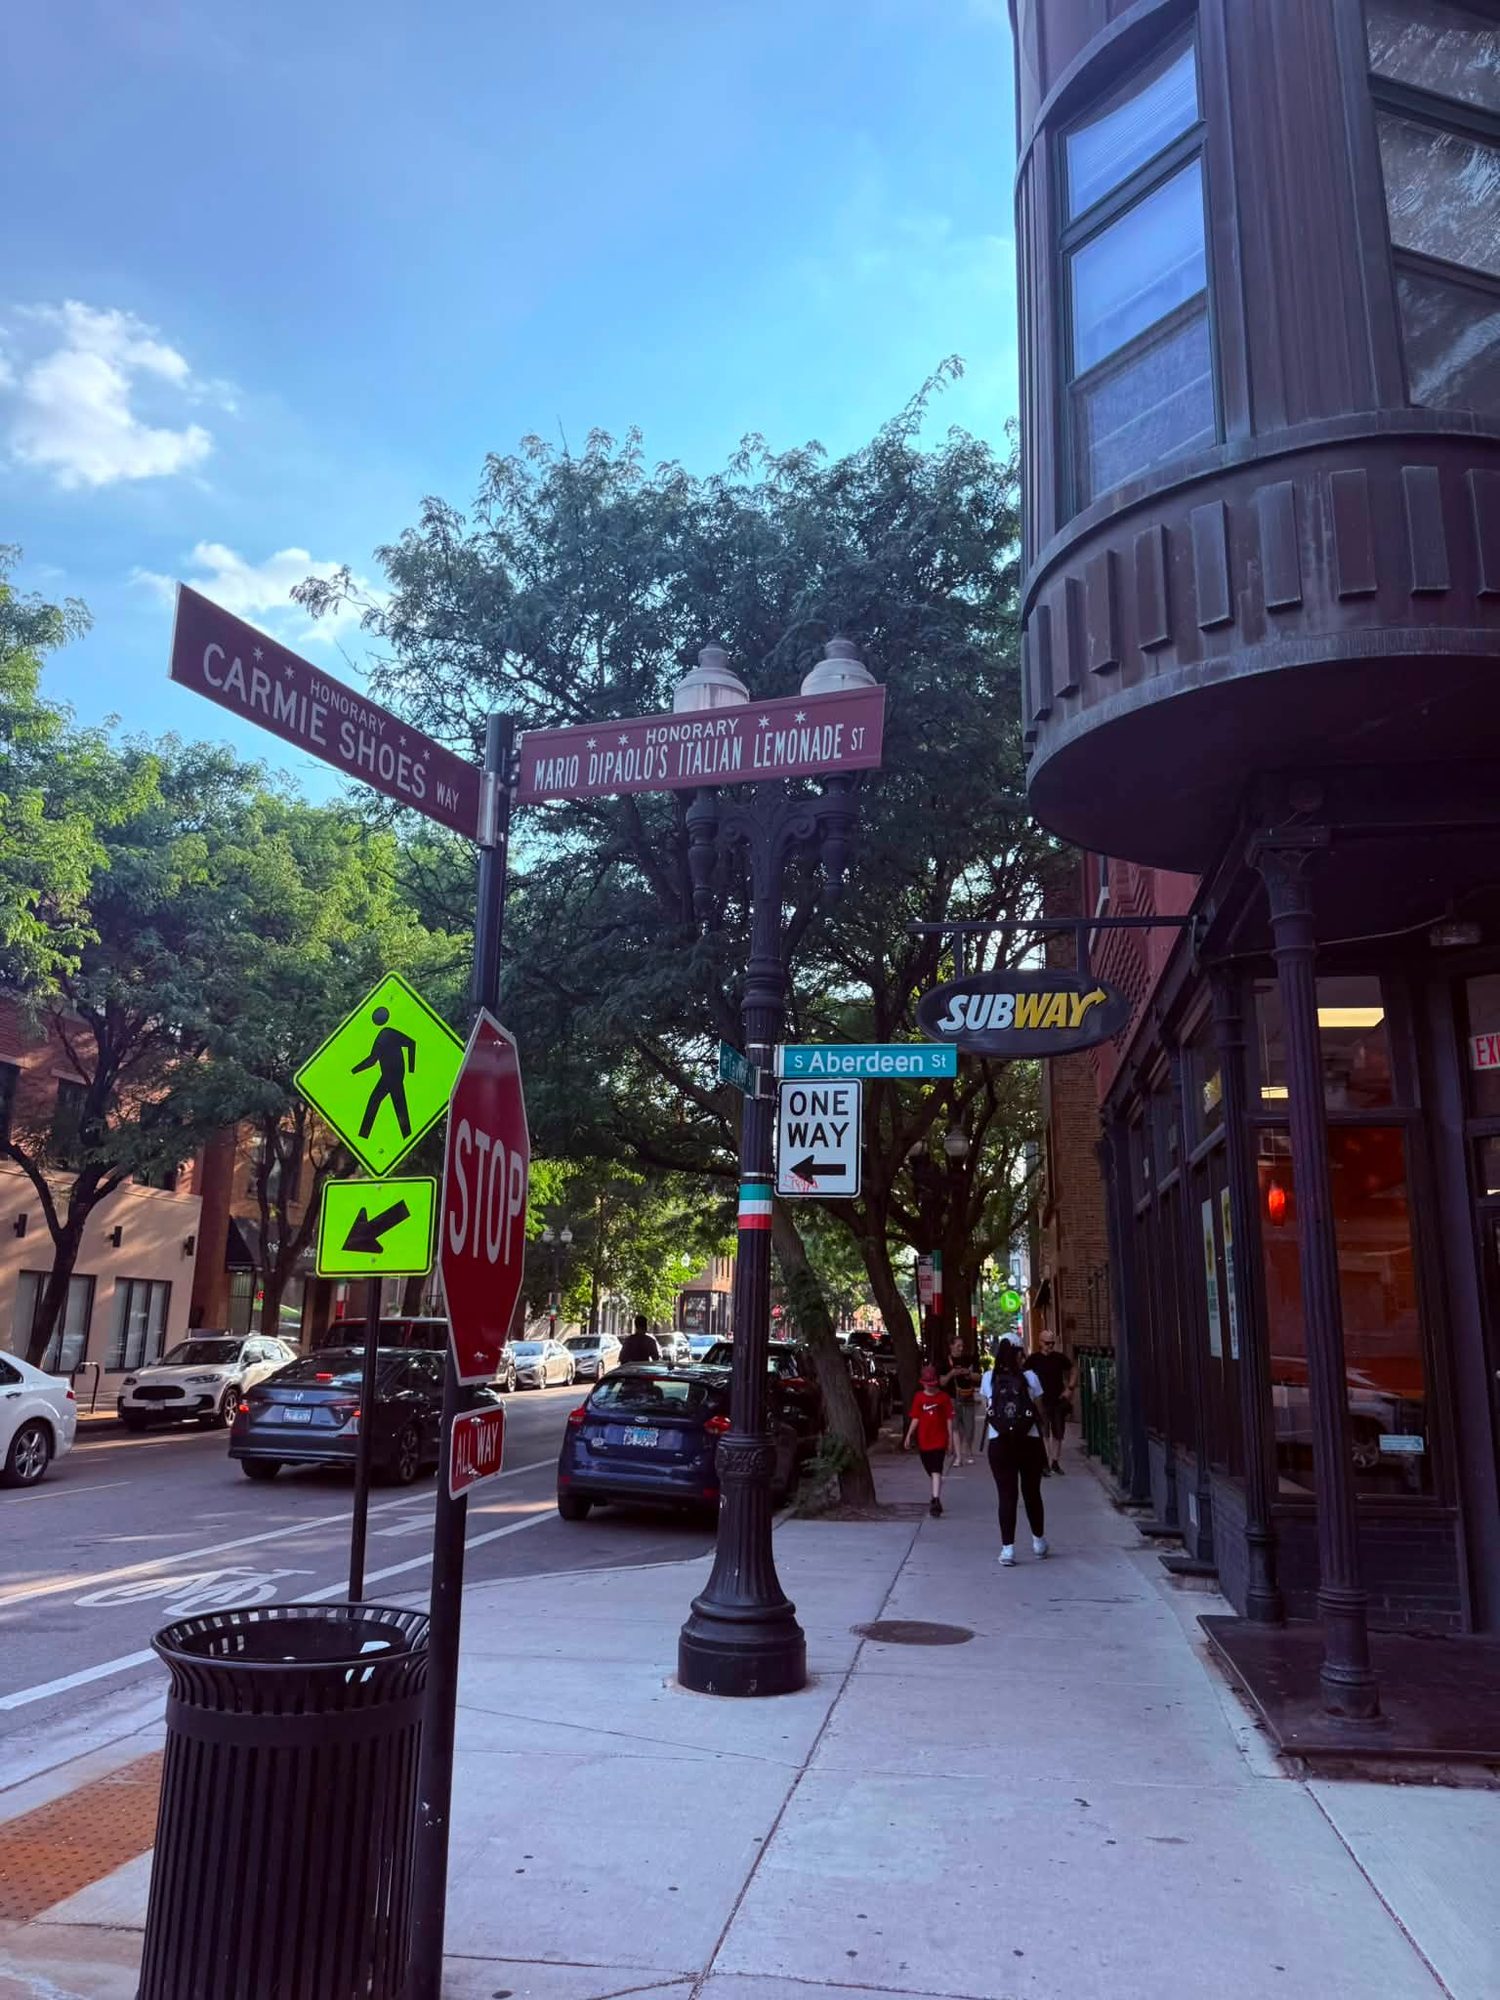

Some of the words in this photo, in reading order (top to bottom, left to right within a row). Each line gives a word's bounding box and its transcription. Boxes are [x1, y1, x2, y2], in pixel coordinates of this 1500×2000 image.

[203, 643, 328, 746] CARMIE
[339, 723, 426, 800] SHOES
[436, 780, 460, 813] WAY
[310, 678, 386, 736] HONORARY
[646, 718, 739, 745] HONORARY
[534, 755, 579, 792] MARIO
[588, 745, 668, 787] DIPAOLO'S
[678, 735, 743, 776] ITALIAN
[753, 724, 842, 768] LEMONADE
[851, 727, 865, 751] ST
[938, 988, 1107, 1032] SUBWAY
[794, 1055, 804, 1069] S
[808, 1050, 924, 1074] Aberdeen
[931, 1053, 946, 1069] St
[789, 1090, 849, 1117] ONE
[788, 1121, 849, 1148] WAY
[449, 1118, 523, 1265] STOP
[455, 1429, 472, 1477] ALL
[477, 1422, 499, 1466] WAY
